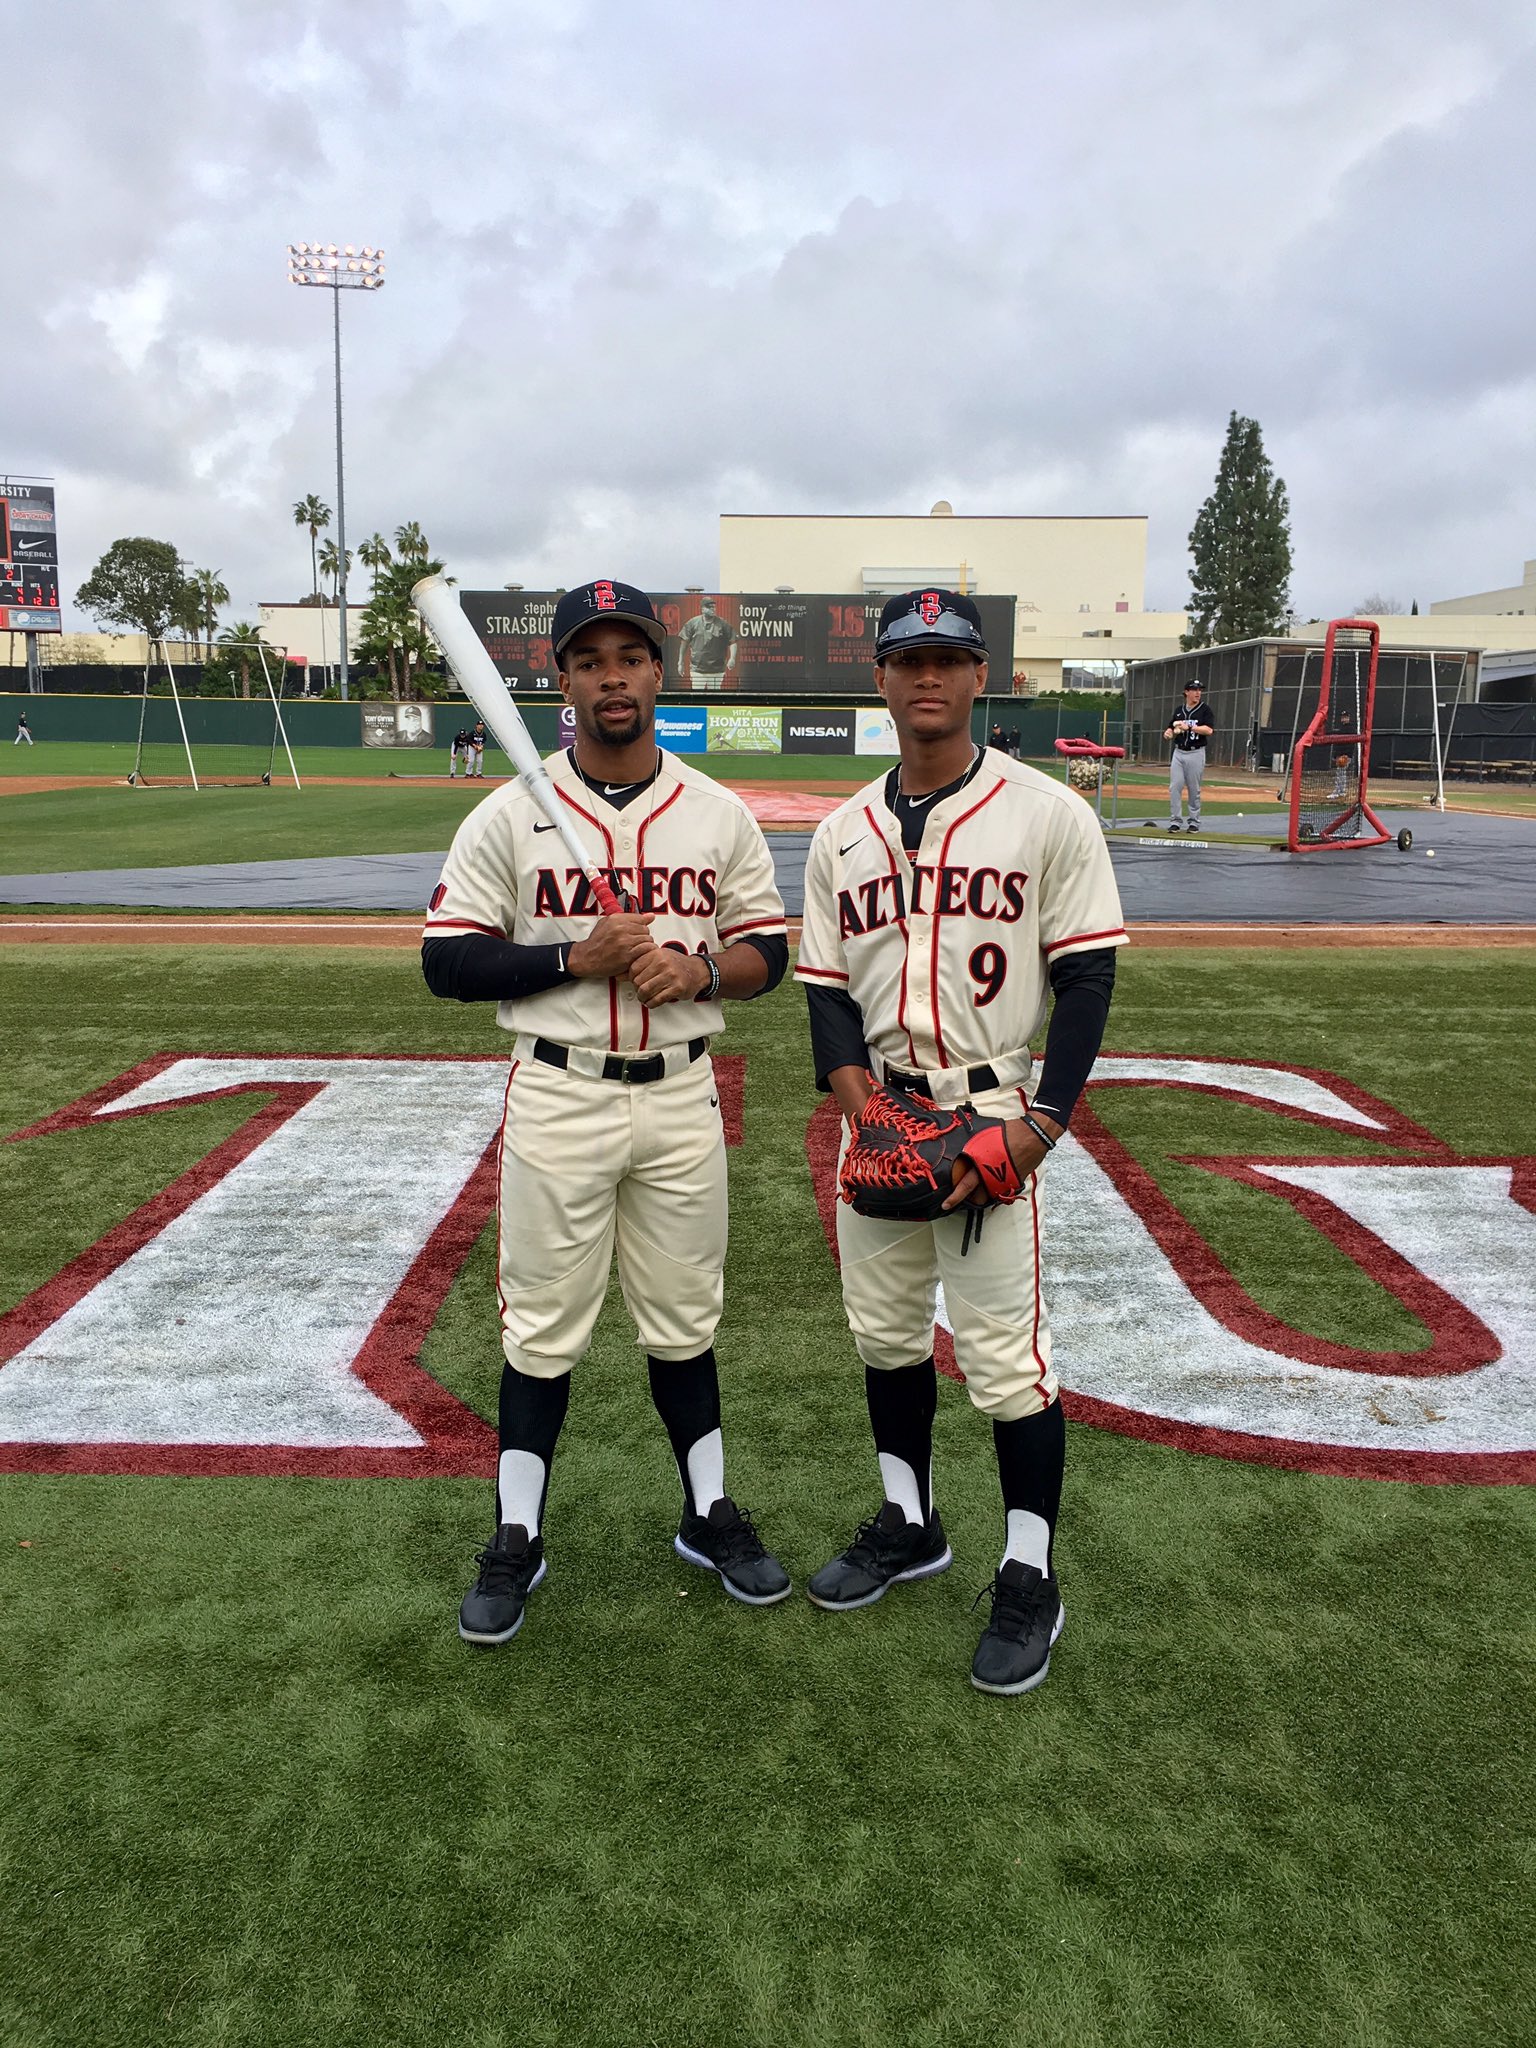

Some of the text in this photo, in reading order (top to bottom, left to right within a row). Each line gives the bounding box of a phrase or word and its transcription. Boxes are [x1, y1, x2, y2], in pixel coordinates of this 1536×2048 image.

[740, 604, 767, 620] tony
[865, 606, 883, 618] tra
[740, 620, 793, 637] GWYNN
[828, 606, 865, 638] 16
[504, 678, 549, 688] 37 19
[655, 719, 704, 730] Wawanesa
[710, 717, 778, 728] HOME RUN
[790, 726, 848, 737] NISSAN
[837, 865, 1029, 942] AZTECS
[968, 942, 1008, 1008] 9
